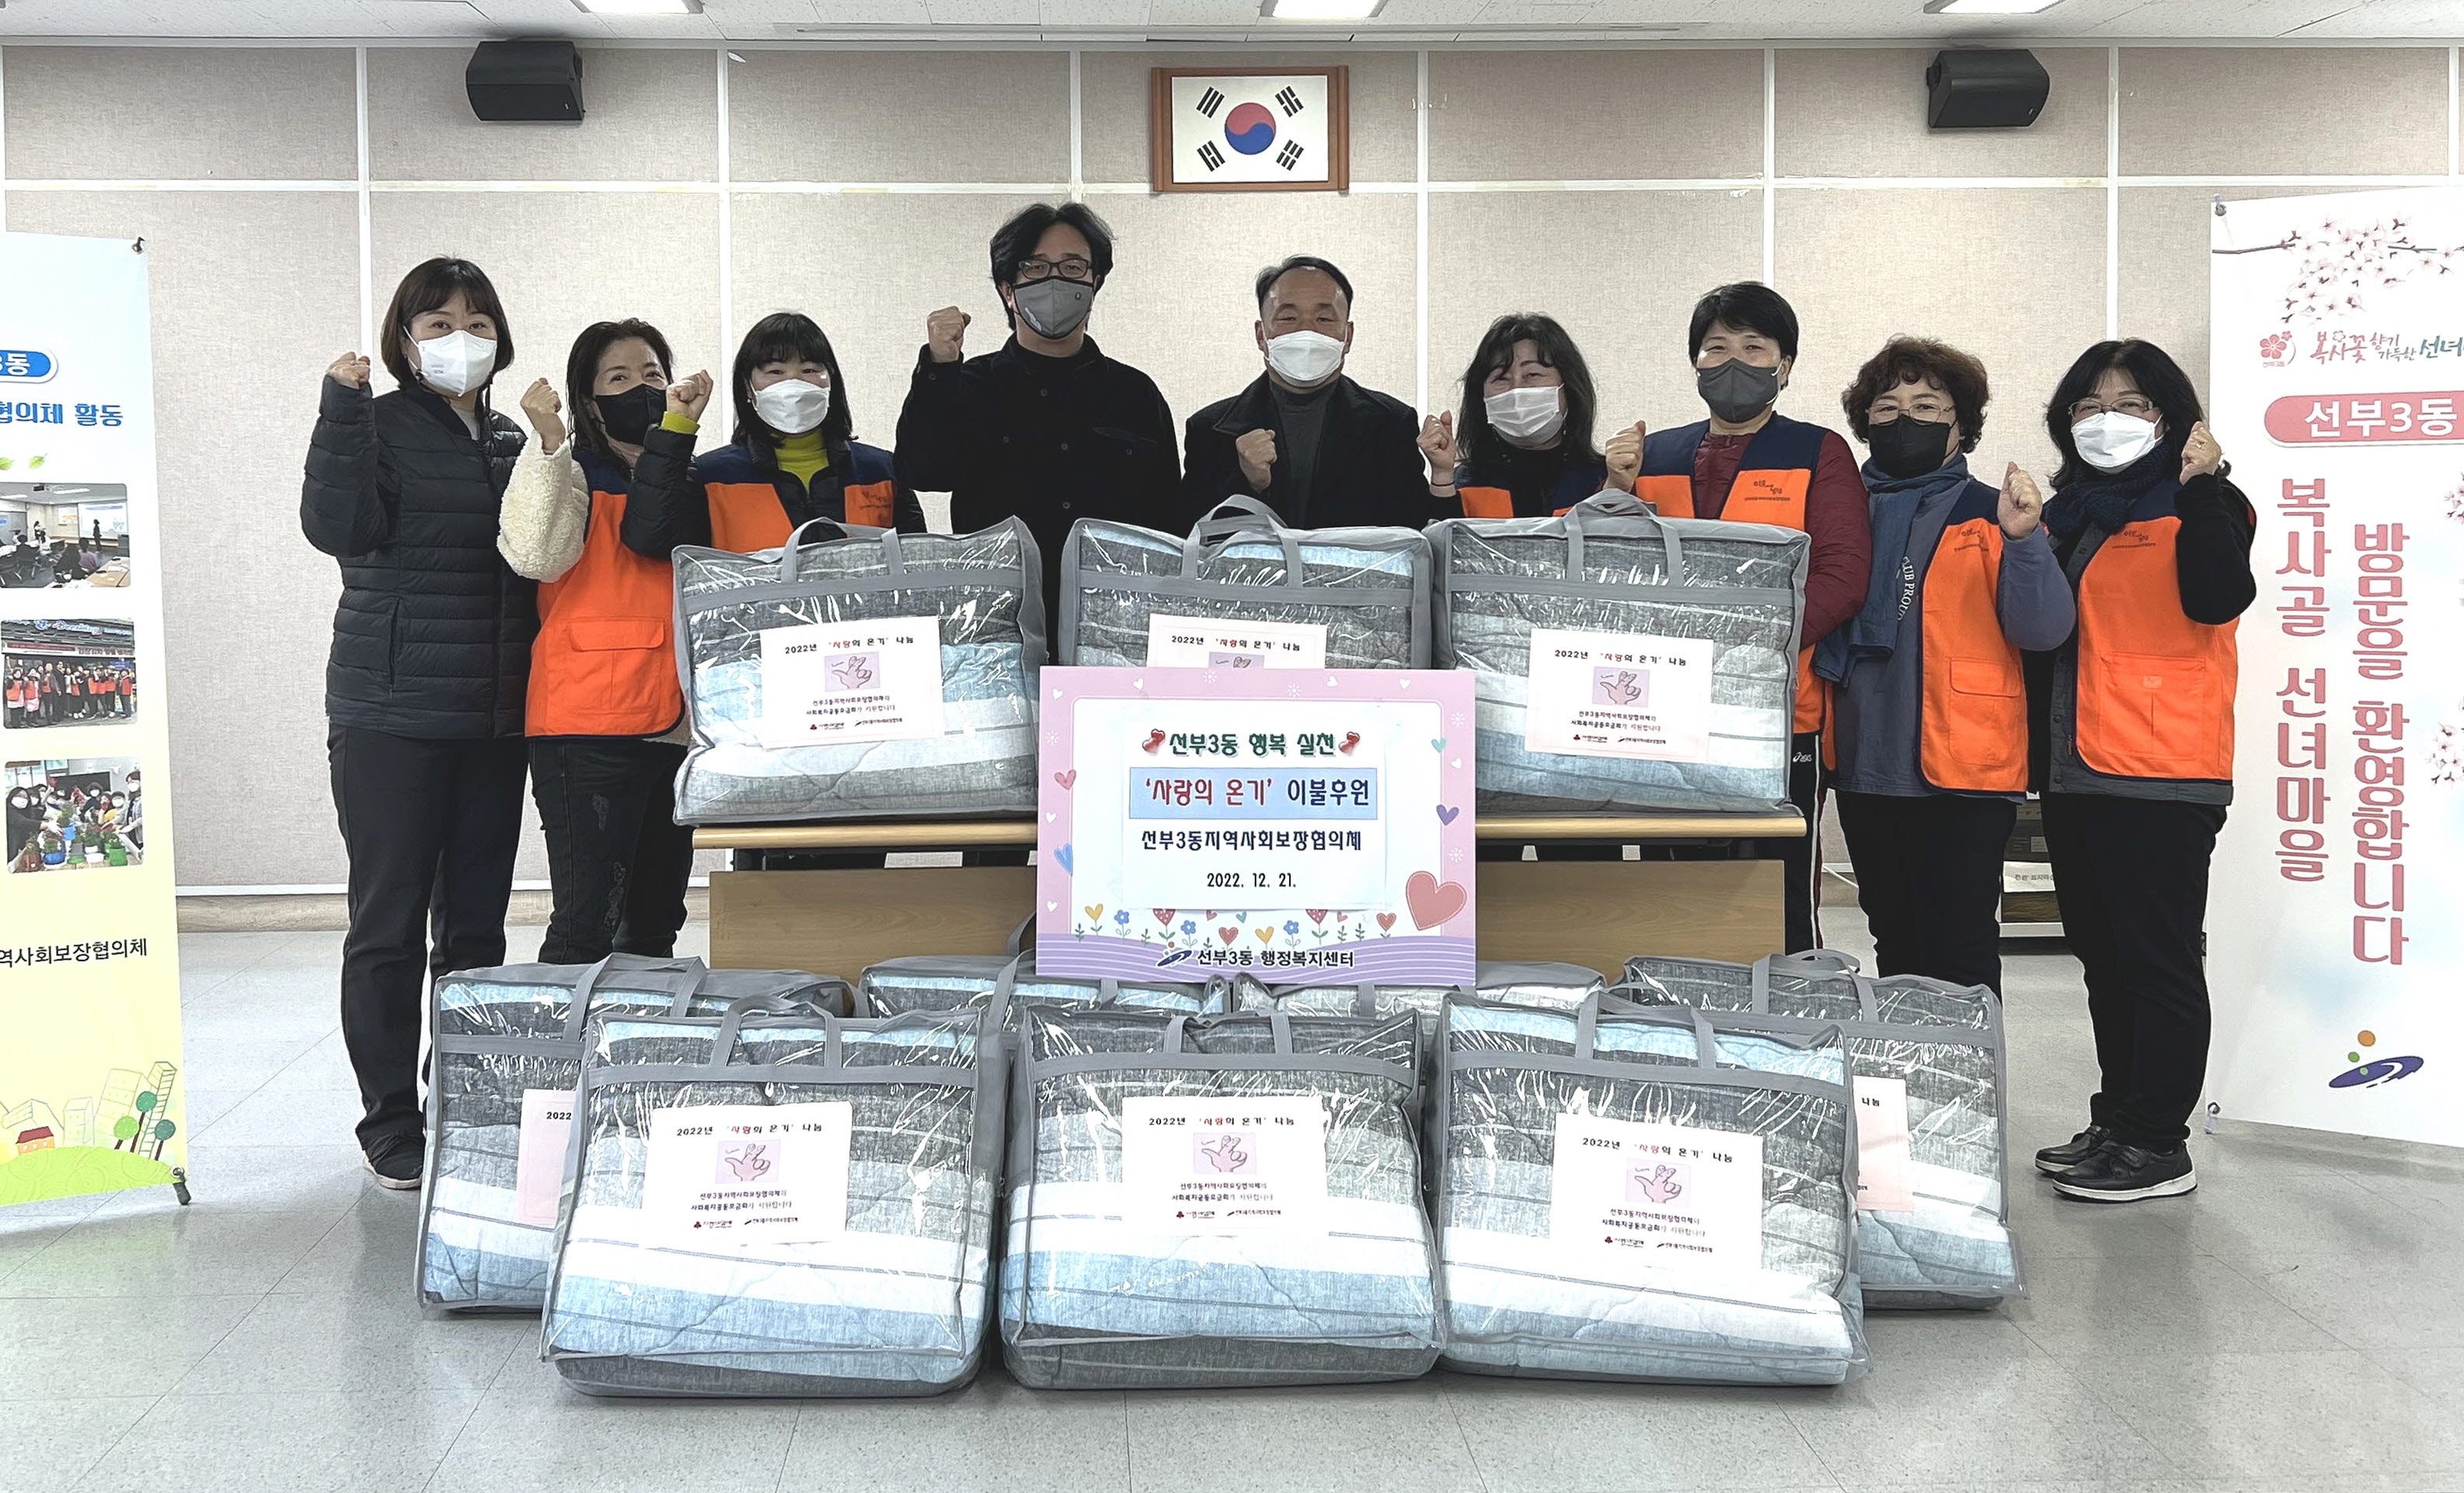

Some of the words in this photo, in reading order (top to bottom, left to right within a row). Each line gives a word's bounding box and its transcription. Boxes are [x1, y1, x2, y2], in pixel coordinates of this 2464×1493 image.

[2419, 335, 2464, 359] 선녀
[0, 352, 31, 376] 동
[74, 403, 124, 427] 활동
[2303, 396, 2460, 440] 선부3동
[2274, 477, 2333, 637] 복사골
[2352, 522, 2410, 681] 방문을
[784, 643, 817, 654] 2022년
[1171, 635, 1204, 646] 2022년
[1554, 649, 1588, 660] 2022년
[1169, 733, 1240, 758] 선부3동
[1248, 733, 1288, 758] 행복
[1296, 733, 1336, 756] 실천
[2274, 667, 2332, 882] 선녀마을
[1287, 778, 1369, 806] 이불후원
[1141, 829, 1361, 852] 선부3동지역사회보장협의체
[2351, 699, 2410, 966] 환영합니다
[1207, 872, 1244, 888] 2022.
[1252, 872, 1270, 888] 12.
[1278, 872, 1296, 888] 21.
[1197, 949, 1254, 967] 선부3동
[1260, 949, 1354, 968] 행정복지센터
[545, 1111, 572, 1121] 2022
[1148, 1117, 1186, 1126] 2022년
[676, 1126, 713, 1137] 2022년
[1582, 1137, 1621, 1150] 2022년
